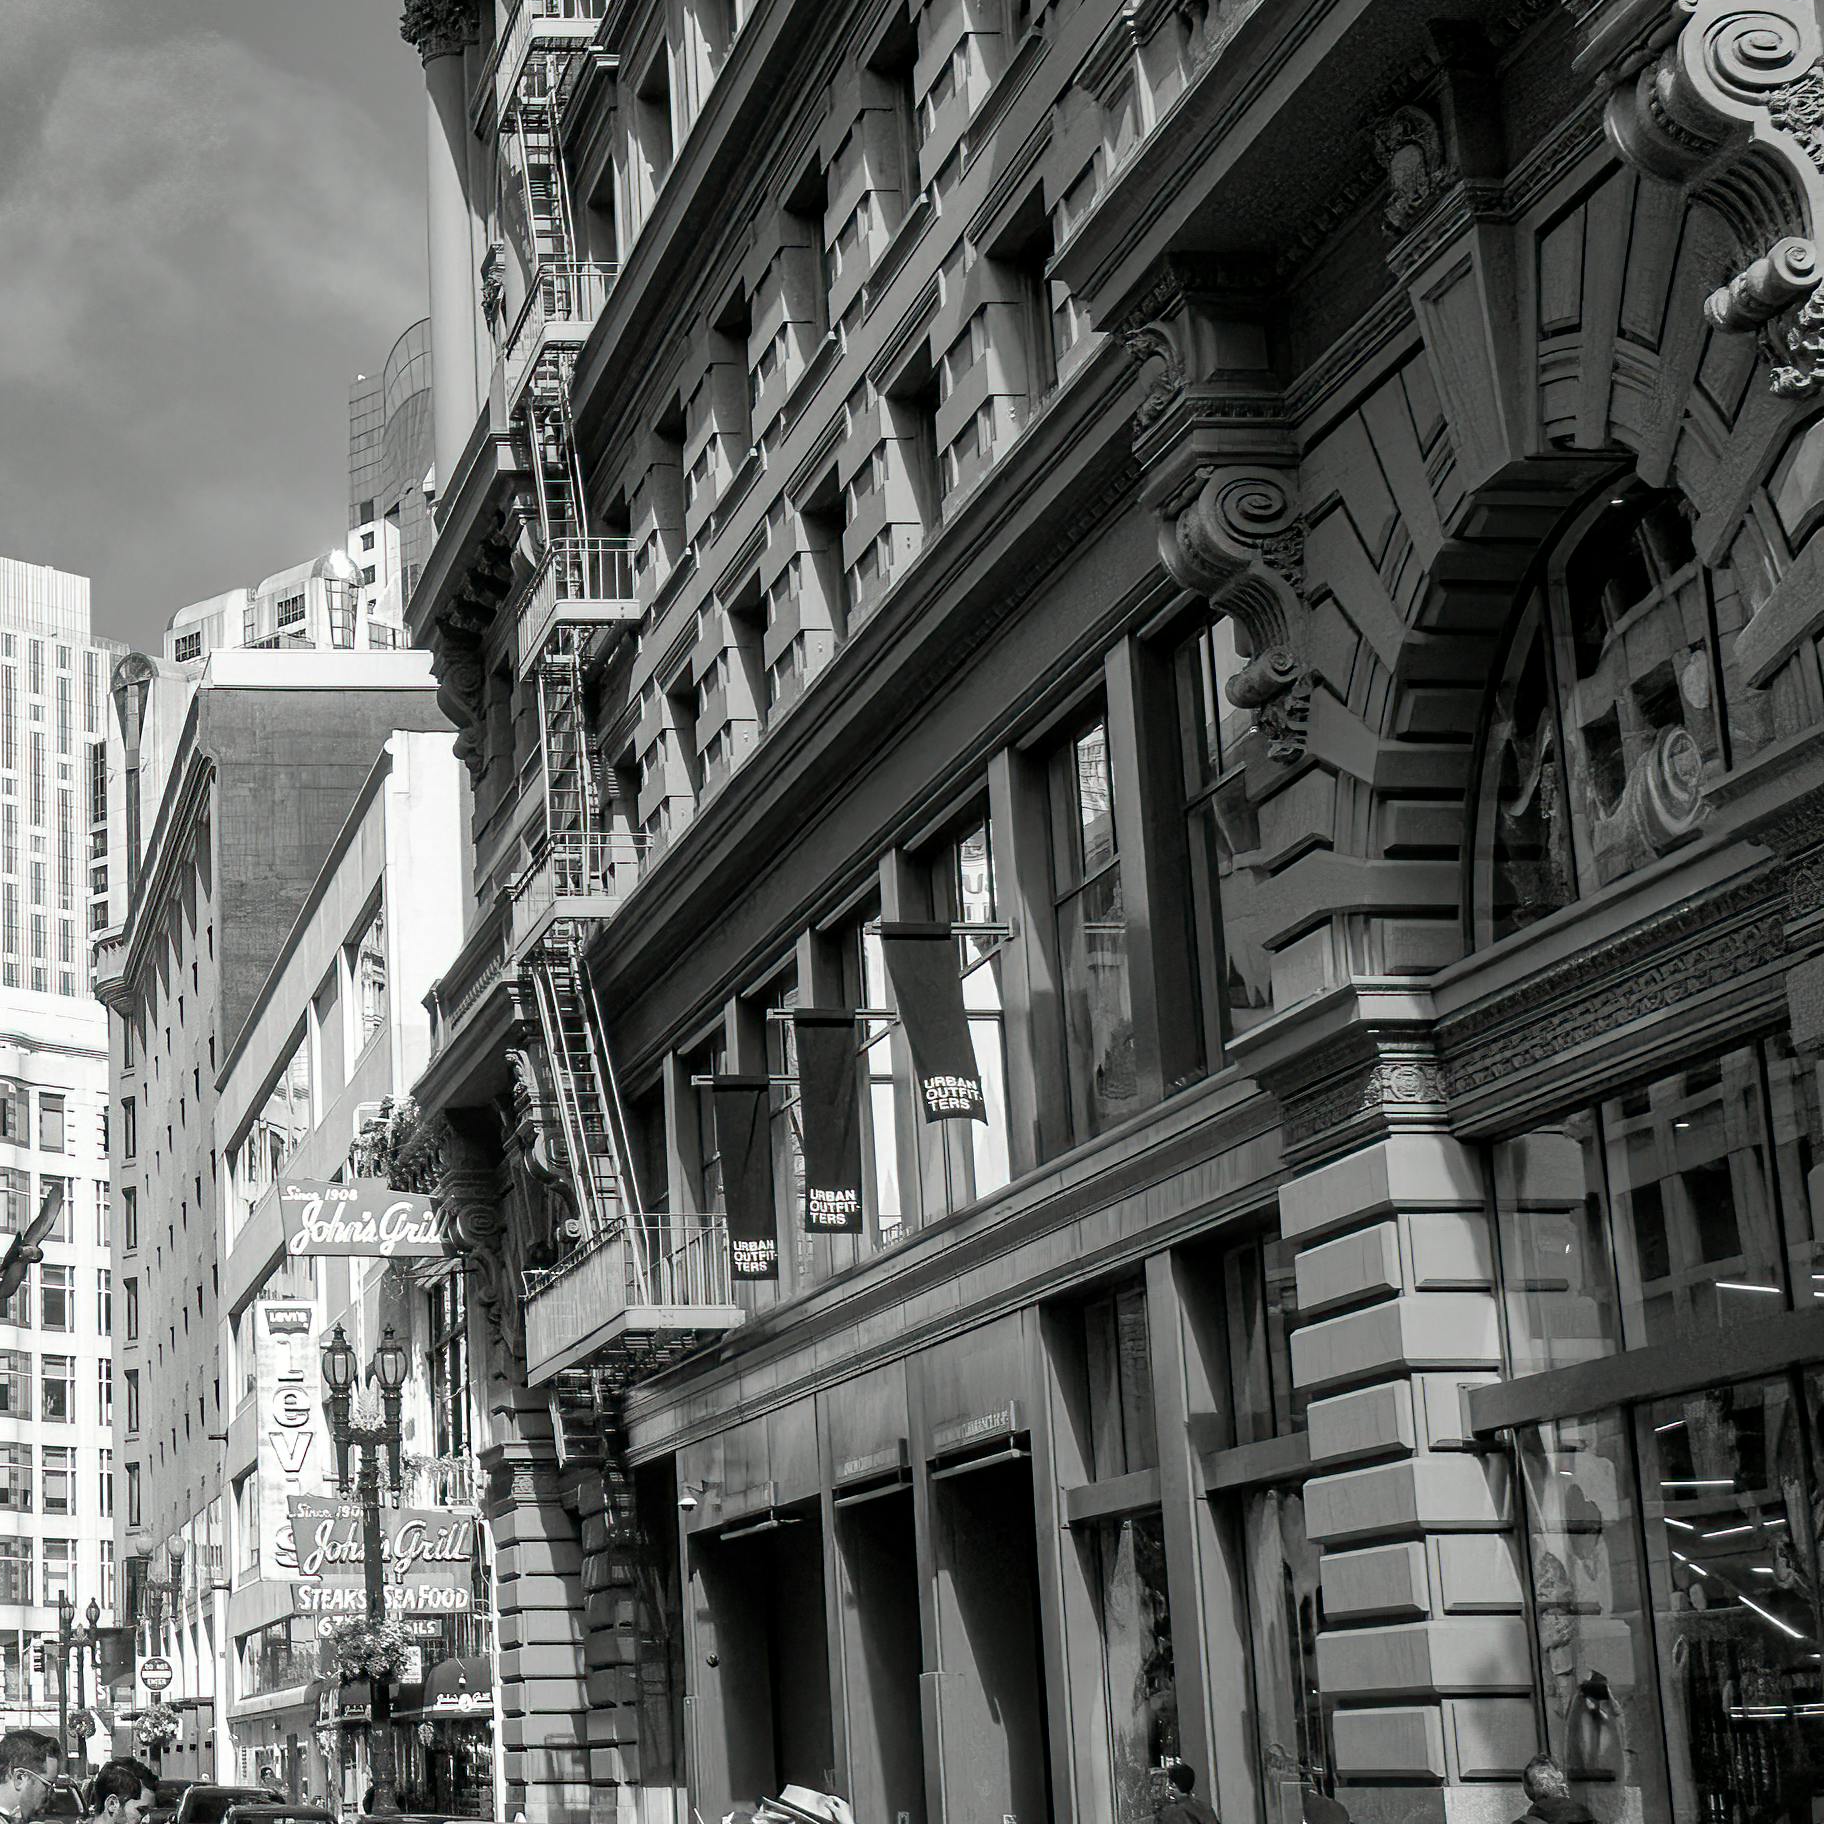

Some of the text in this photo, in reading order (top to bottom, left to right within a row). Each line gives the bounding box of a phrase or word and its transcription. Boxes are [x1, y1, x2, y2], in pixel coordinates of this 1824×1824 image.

[924, 1077, 977, 1090] URBAN
[928, 1098, 971, 1111] TERS
[282, 1186, 358, 1200] Since 1908
[810, 1189, 855, 1201] URBAN
[810, 1200, 861, 1212] OUTFIT-
[810, 1212, 846, 1224] TERS
[289, 1200, 378, 1255] John's
[733, 1240, 774, 1251] URBAN
[734, 1250, 778, 1262] OUTFIT-
[735, 1261, 768, 1272] TERS
[393, 1519, 472, 1575] Grill
[298, 1585, 367, 1610] STEAKS
